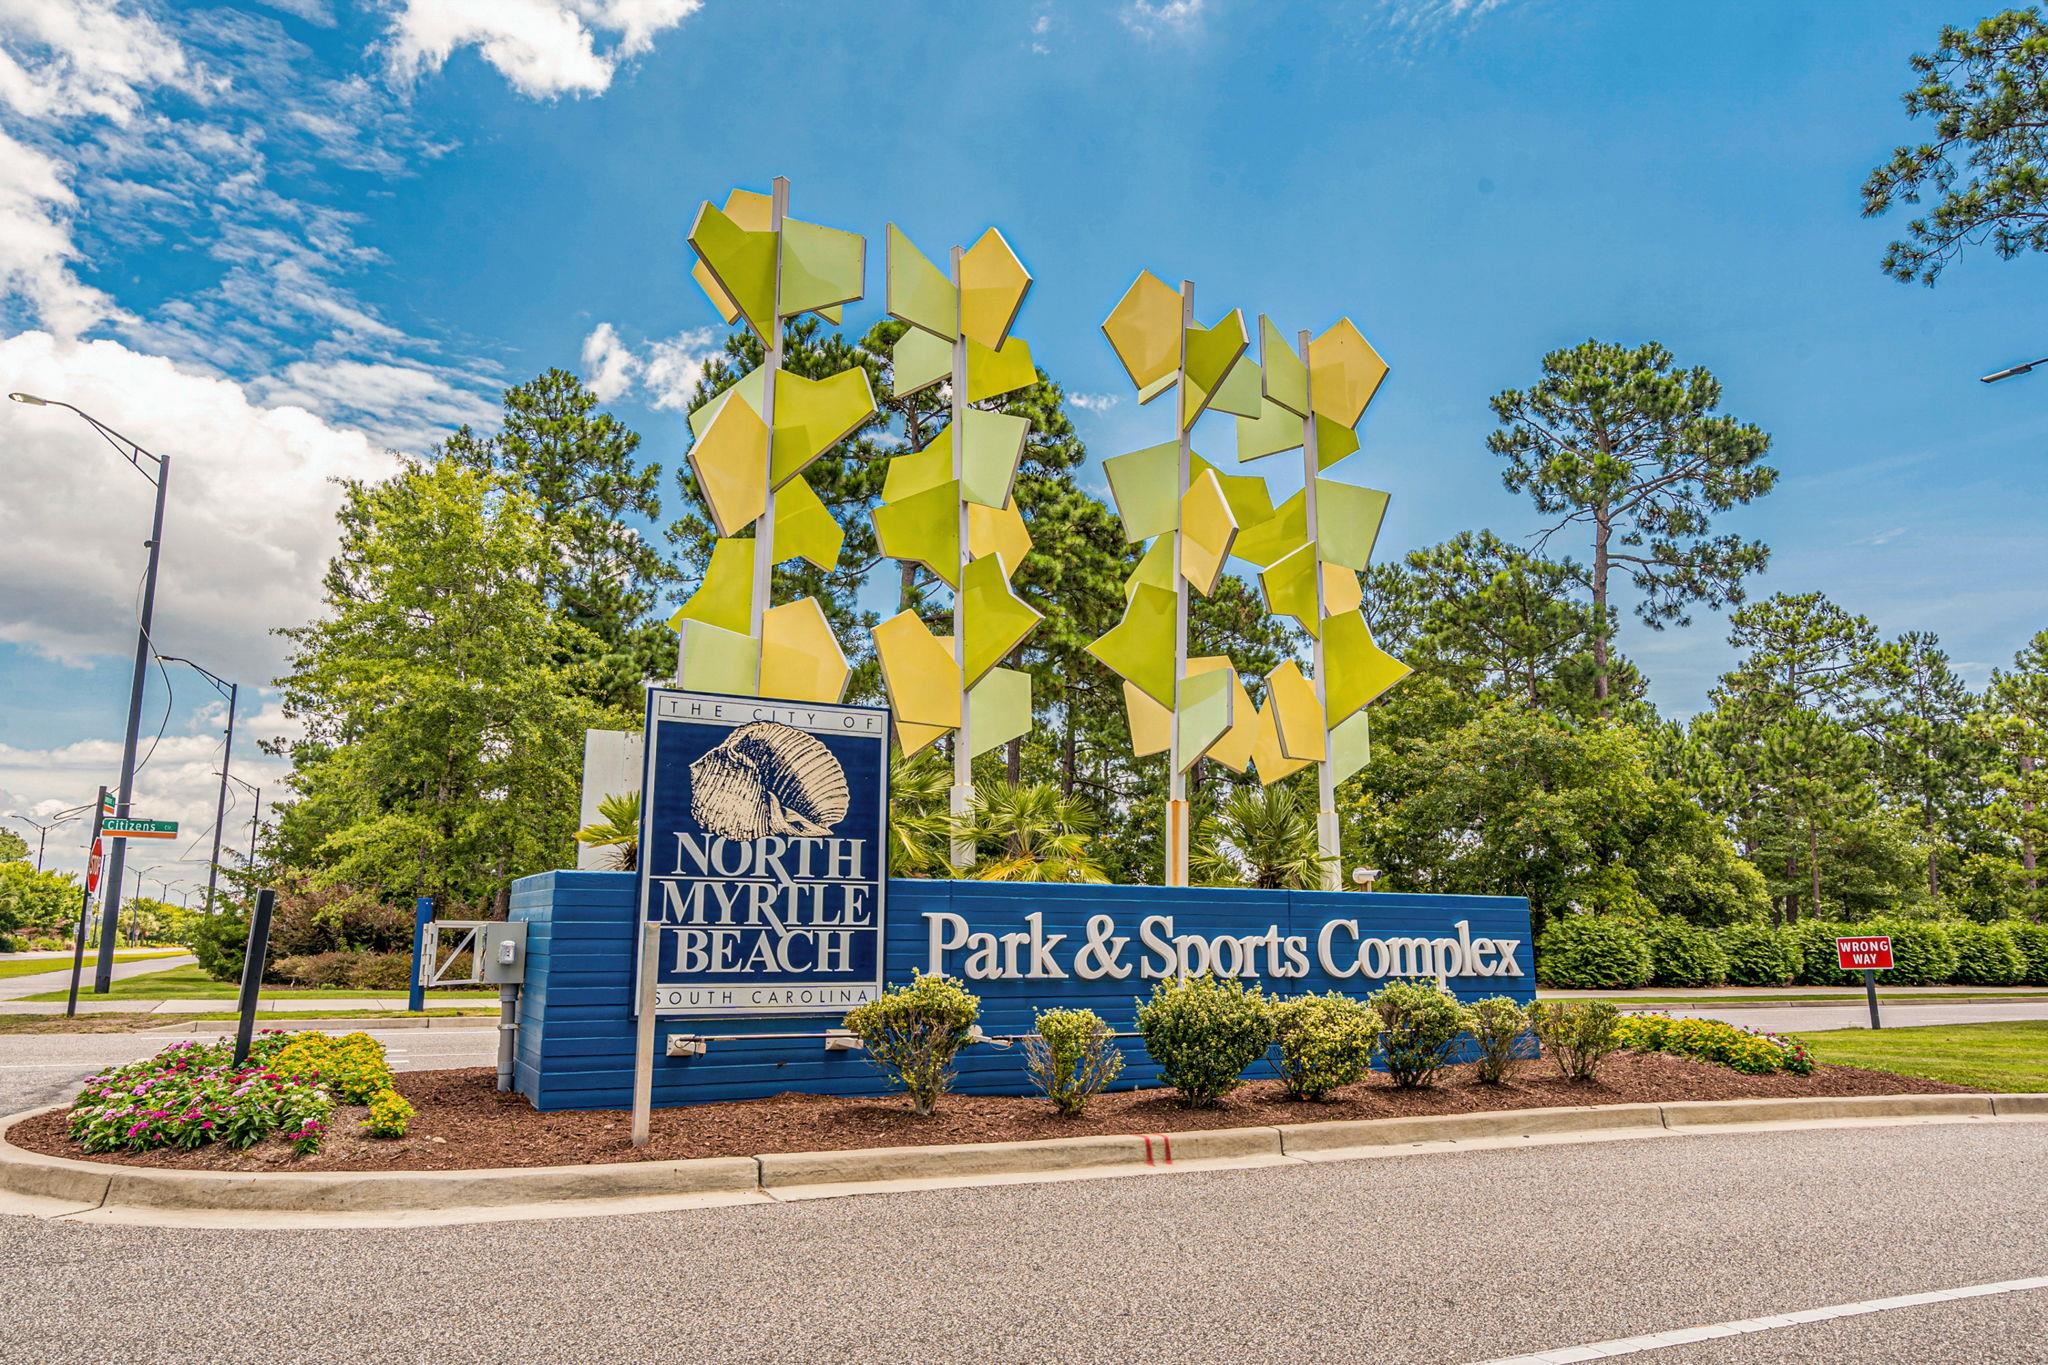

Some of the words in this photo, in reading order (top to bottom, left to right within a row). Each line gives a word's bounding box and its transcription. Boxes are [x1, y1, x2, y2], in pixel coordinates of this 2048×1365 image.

[670, 701, 722, 717] THE
[752, 708, 815, 724] CITY
[843, 716, 874, 730] OF
[107, 820, 156, 831] Citizens
[671, 832, 867, 885] NORTH
[660, 881, 871, 936] MYRTLE
[670, 929, 854, 974] BEACH
[921, 911, 1069, 980] Park
[1073, 914, 1133, 980] &
[1139, 915, 1310, 989] Sports
[1317, 919, 1525, 993] Complex
[1840, 940, 1889, 953] WRONG
[1853, 953, 1877, 965] WAY
[656, 991, 732, 1005] SOUTH
[752, 989, 868, 1005] CAROLINA
